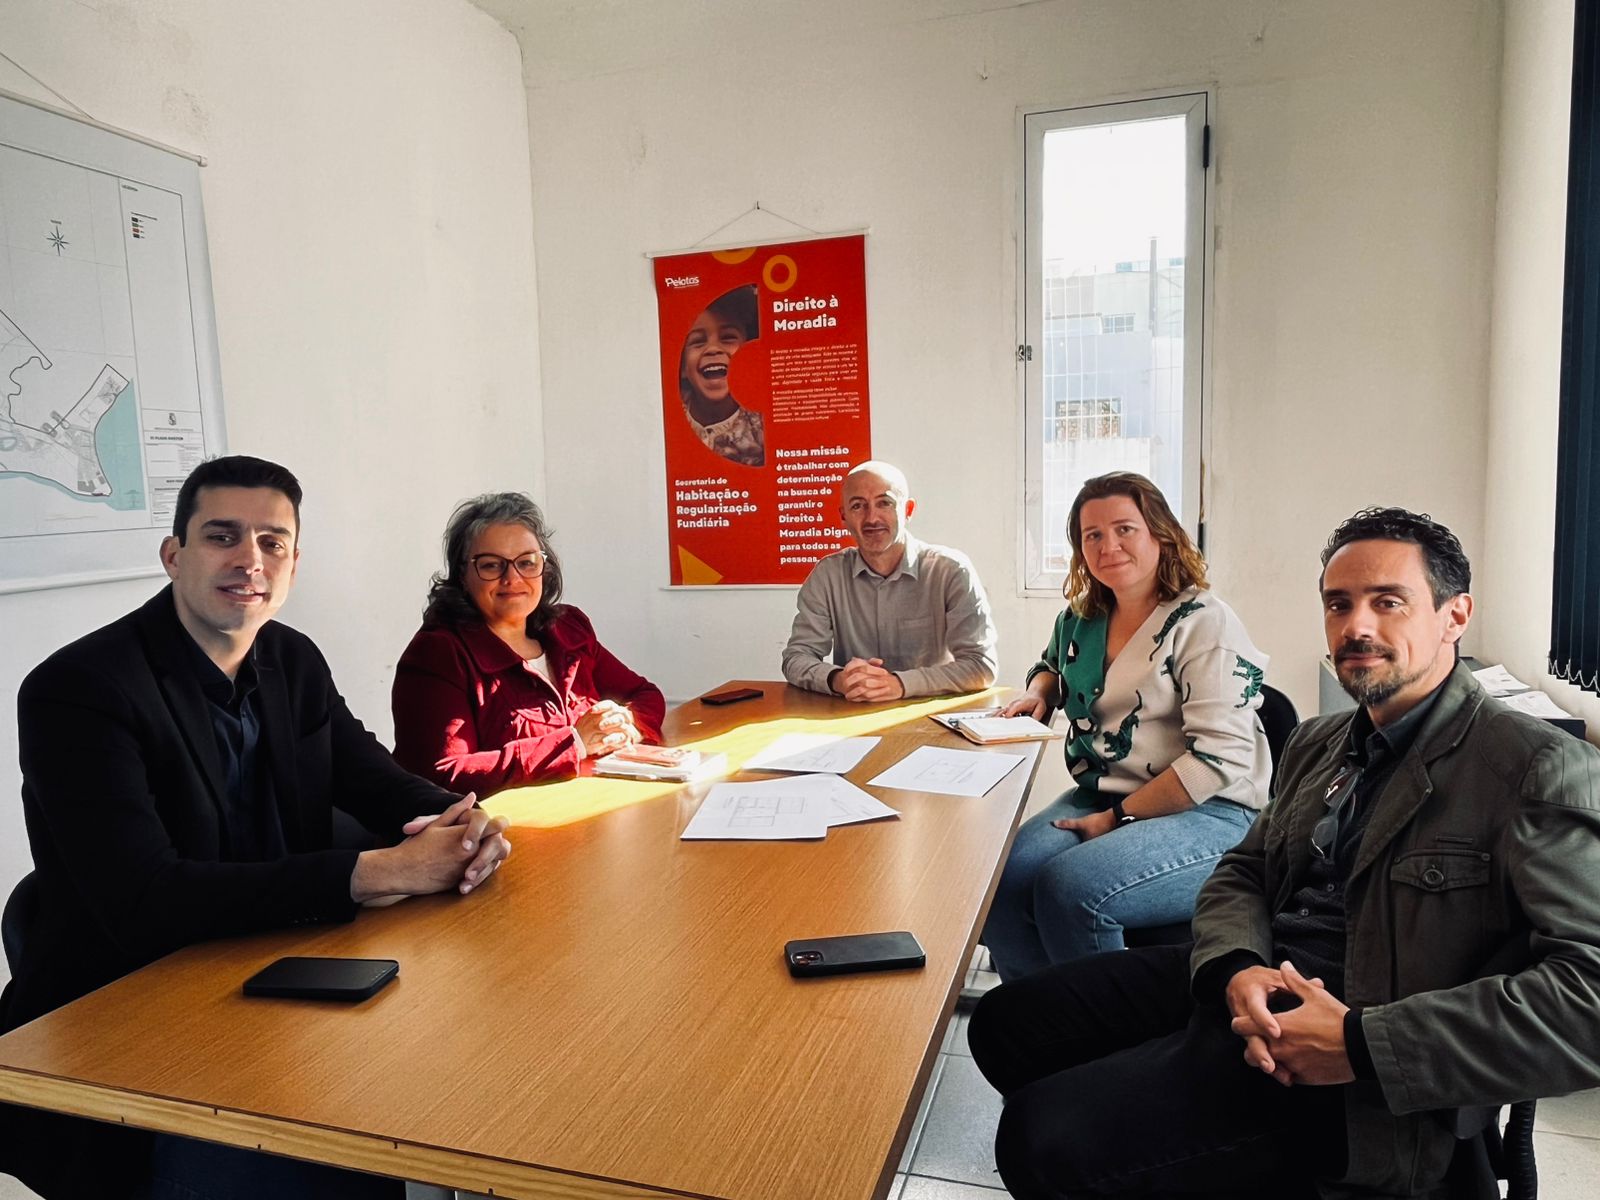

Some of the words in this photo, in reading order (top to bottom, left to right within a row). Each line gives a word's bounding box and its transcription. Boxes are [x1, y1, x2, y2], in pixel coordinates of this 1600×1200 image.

[773, 296, 826, 313] Direito
[829, 294, 839, 308] à
[774, 313, 837, 332] Moradia
[776, 448, 809, 458] Nossa
[810, 445, 850, 457] missão
[784, 461, 828, 471] trabalhar
[829, 461, 850, 469] com
[675, 477, 716, 486] Secretaria
[717, 477, 728, 485] de
[777, 473, 843, 484] determinação
[676, 488, 740, 502] Habitação
[790, 488, 819, 497] busca
[820, 486, 832, 495] de
[676, 502, 757, 517] Regularização
[778, 500, 816, 511] garantir
[677, 516, 730, 529] Fundiária
[779, 513, 815, 523] Direito
[816, 512, 824, 522] à
[779, 527, 822, 538] Moradia
[780, 544, 801, 553] para
[802, 542, 829, 550] todos
